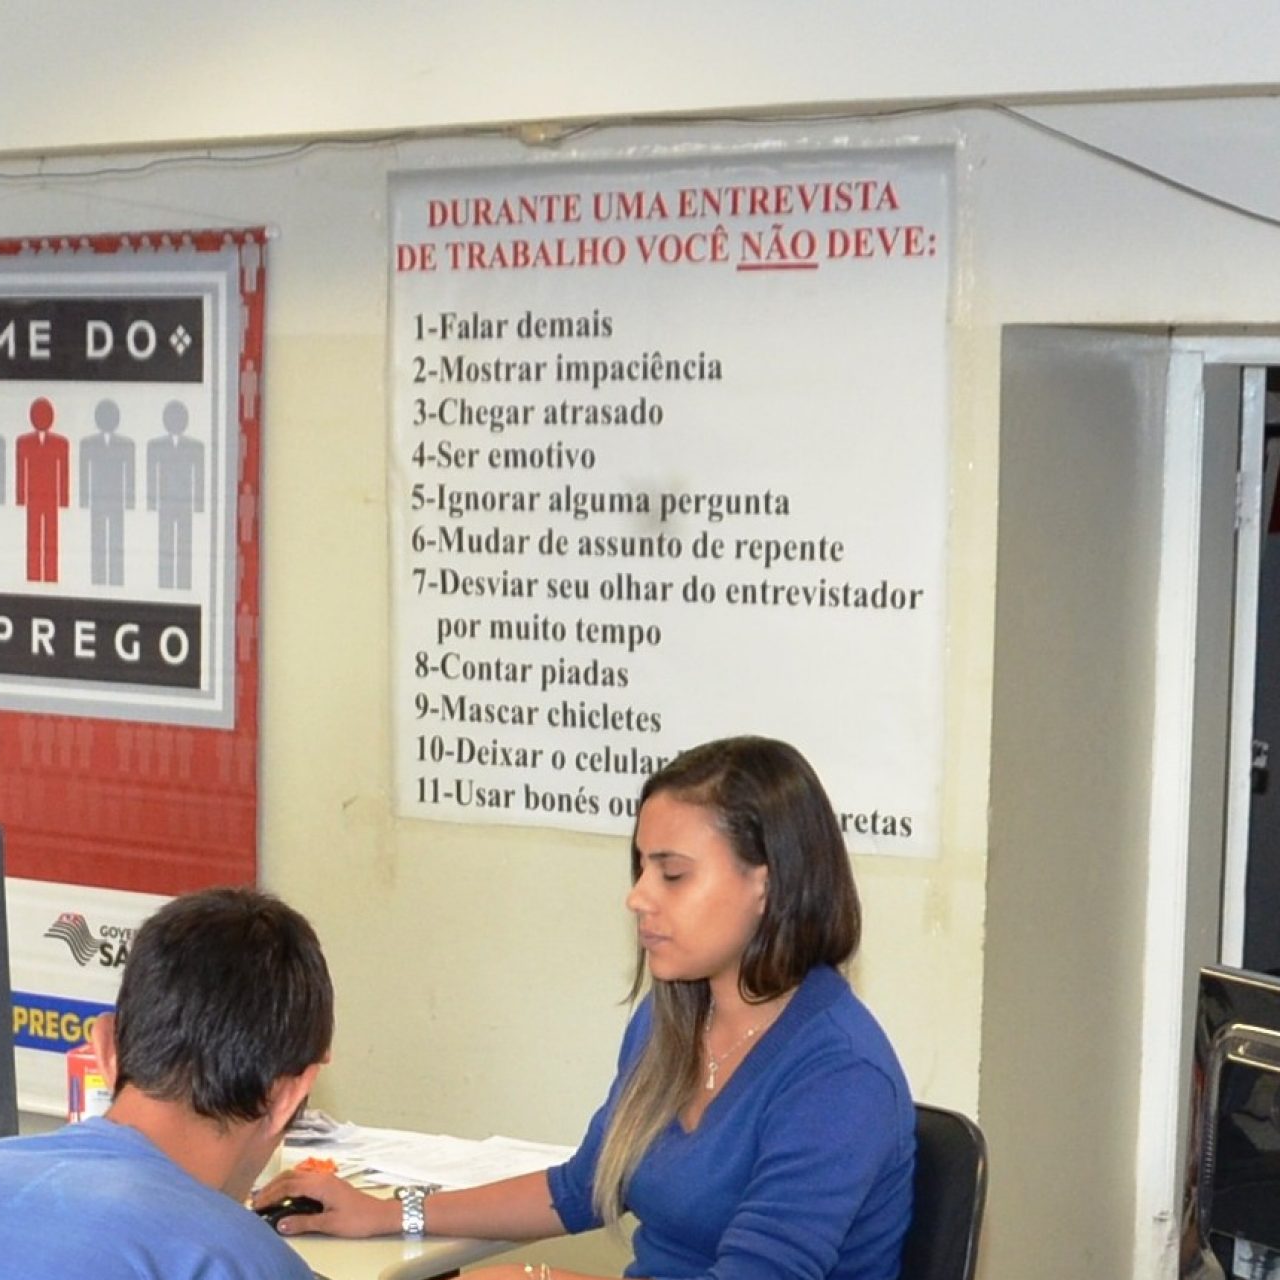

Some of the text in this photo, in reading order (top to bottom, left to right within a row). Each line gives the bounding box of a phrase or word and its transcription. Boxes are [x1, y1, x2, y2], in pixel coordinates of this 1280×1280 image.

[428, 180, 900, 229] DURANTE UMA ENTREVISTA
[396, 223, 939, 273] DE TRABALHO VOCÊ NÃO DEVE:
[85, 319, 158, 360] DO
[413, 309, 614, 342] 1-Falar demais
[412, 351, 723, 391] 2-Mostrar impaciência
[412, 397, 664, 433] 3-Chegar atrasado
[411, 441, 597, 470] 4-Ser emotivo
[411, 482, 791, 524] 5-Ignorar alguma pergunta
[411, 525, 846, 569] 6-Mudar de assunto de repente
[412, 567, 926, 611] 7-Desviar seu olhar do entrevistador
[436, 613, 663, 654] por muito tempo
[414, 651, 631, 693] 8-Contar piadas
[414, 693, 663, 734] 9-Mascar chicletes
[416, 734, 669, 775] 10-Deixar o celular
[417, 776, 640, 818] 11-Usar bonés ou
